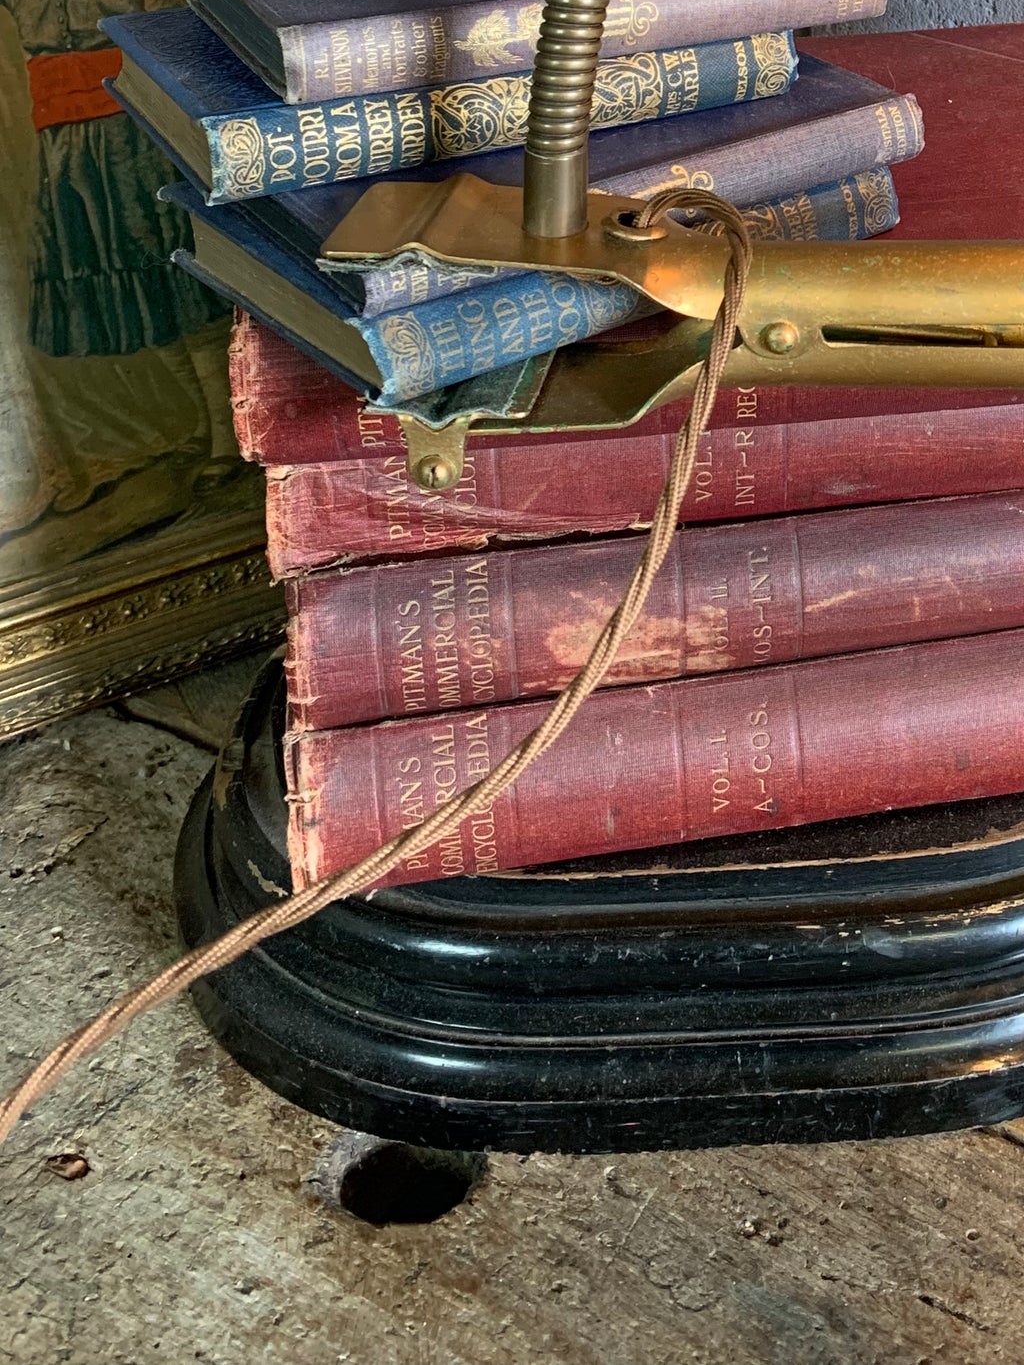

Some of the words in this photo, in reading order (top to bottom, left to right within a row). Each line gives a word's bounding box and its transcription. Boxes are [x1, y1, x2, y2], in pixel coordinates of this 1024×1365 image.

[330, 27, 353, 94] STEVENSON
[361, 25, 379, 89] Memories
[377, 43, 392, 71] and
[389, 19, 409, 83] Portraits
[411, 22, 428, 65] other
[733, 41, 748, 102] NELSON
[330, 100, 356, 119] A
[680, 48, 699, 112] EARLE
[297, 106, 331, 187] POURRI
[333, 123, 363, 183] FROM
[363, 99, 394, 175] SURREY
[393, 92, 427, 169] GARDEN
[888, 105, 907, 157] EDITION
[430, 318, 466, 379] THE
[456, 299, 496, 375] RING
[492, 296, 525, 356] AND
[520, 287, 554, 350] THE
[695, 445, 713, 504] VOL.
[395, 599, 427, 713] PITMAN'S
[430, 569, 463, 709] OMMERCIAL
[395, 756, 430, 871] PIAN'S
[711, 751, 731, 813] VOL.
